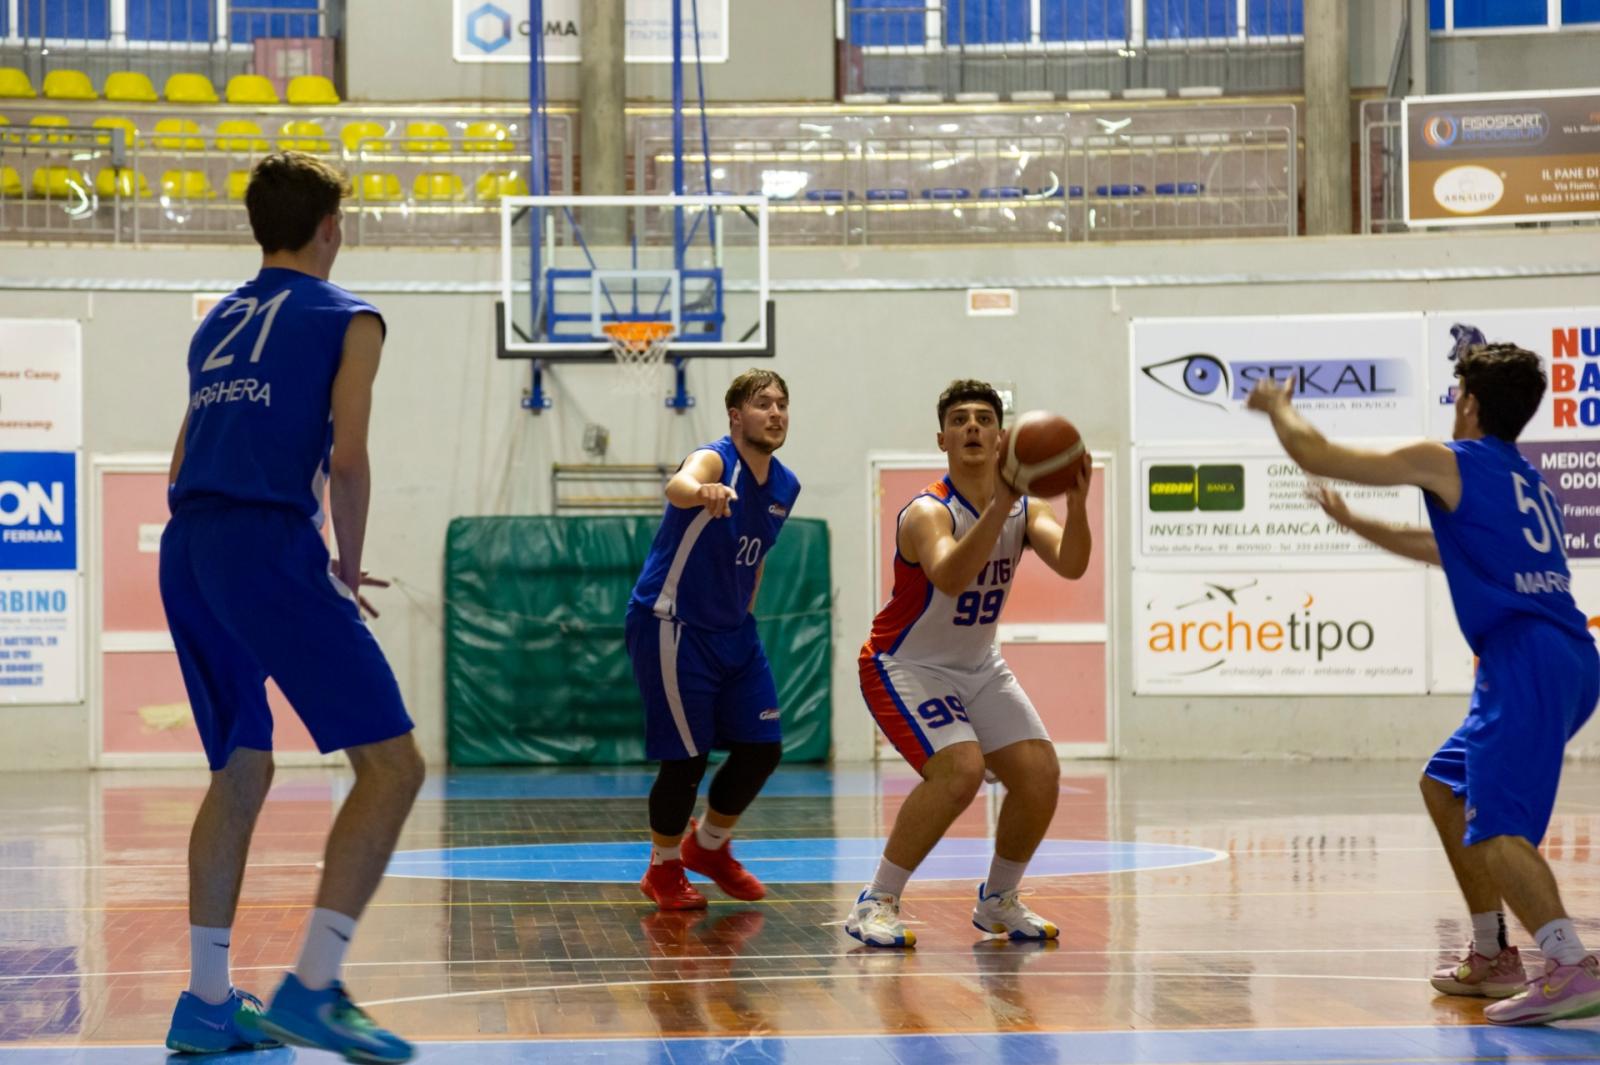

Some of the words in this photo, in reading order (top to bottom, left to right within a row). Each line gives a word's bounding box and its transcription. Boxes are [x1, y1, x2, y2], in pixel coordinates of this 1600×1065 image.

[517, 19, 579, 37] CMA
[1461, 113, 1542, 129] FISIOSPORT
[1541, 169, 1552, 181] IL
[1554, 167, 1583, 180] PANE
[1586, 166, 1599, 179] DI
[1444, 193, 1496, 203] ARNALDO
[201, 289, 292, 372] 21
[24, 369, 61, 382] Camp
[190, 378, 271, 411] ARGHERA
[1150, 482, 1193, 495] CREDEM
[1206, 482, 1235, 493] BANCA
[3, 529, 64, 543] FERRARA
[1149, 523, 1208, 537] INVESTI
[1212, 522, 1261, 537] NELLA
[1266, 521, 1321, 536] BANCA
[1563, 532, 1590, 550] Tel.
[735, 535, 762, 567] 20
[953, 588, 1005, 627] 99
[1148, 611, 1375, 661] archetipo
[916, 694, 972, 729] 99
